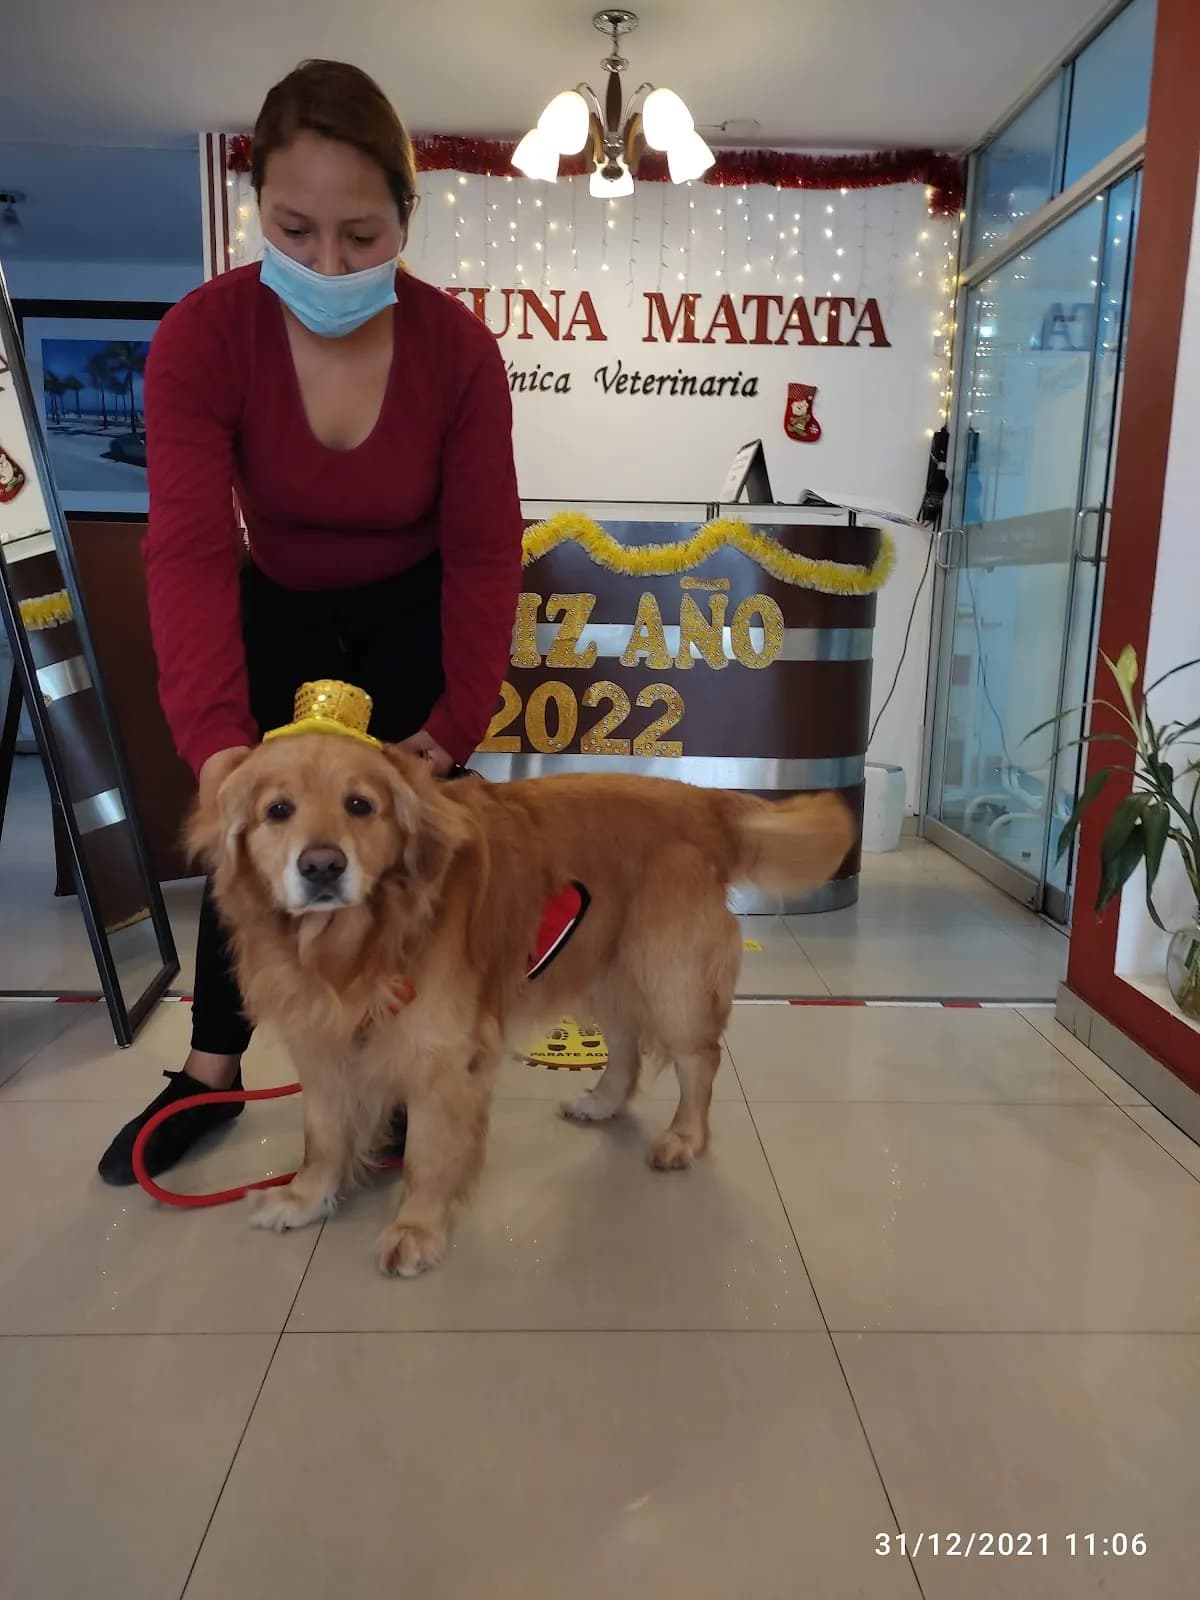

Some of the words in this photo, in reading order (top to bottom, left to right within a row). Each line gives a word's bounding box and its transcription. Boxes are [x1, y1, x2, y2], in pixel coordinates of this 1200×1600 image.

[438, 287, 608, 341] UNA
[642, 292, 892, 348] MATATA
[507, 360, 571, 394] nica
[593, 359, 759, 399] Veterinaria
[619, 576, 785, 670] AÑO
[474, 680, 685, 758] 2022
